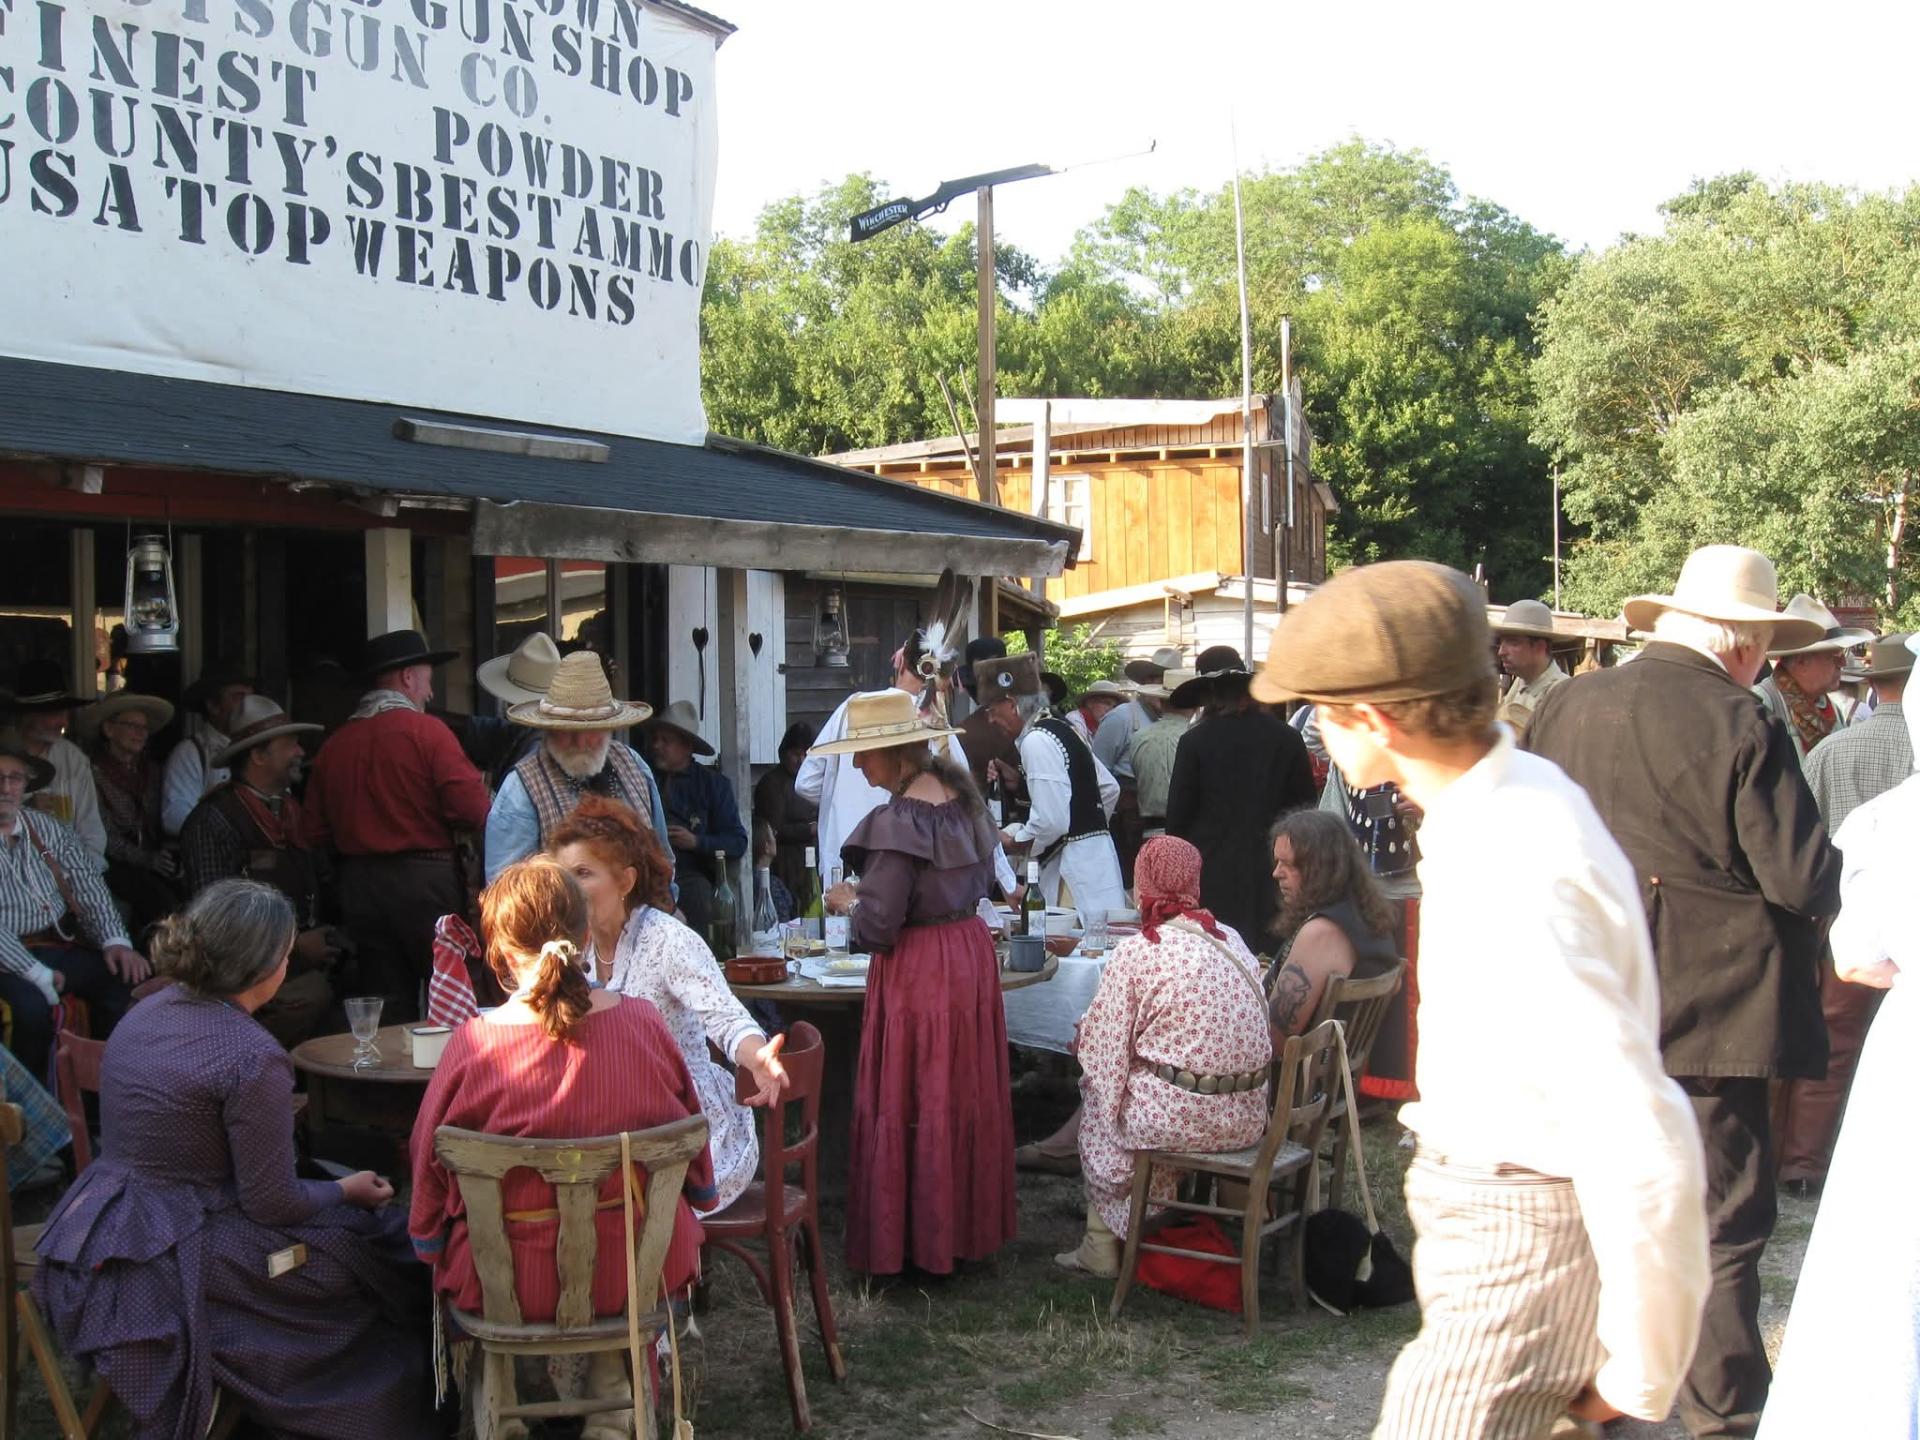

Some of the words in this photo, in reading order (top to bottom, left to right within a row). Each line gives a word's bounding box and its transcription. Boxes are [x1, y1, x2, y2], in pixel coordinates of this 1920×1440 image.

[0, 0, 317, 127] INEST
[432, 106, 665, 221] POWDER
[460, 52, 551, 125] CO.
[552, 24, 694, 118] SHOP
[165, 176, 331, 265] TOP
[345, 213, 635, 326] WEAPONS
[393, 162, 562, 250] BEST
[572, 206, 701, 288] AMMO
[857, 204, 908, 231] WINCHESTER
